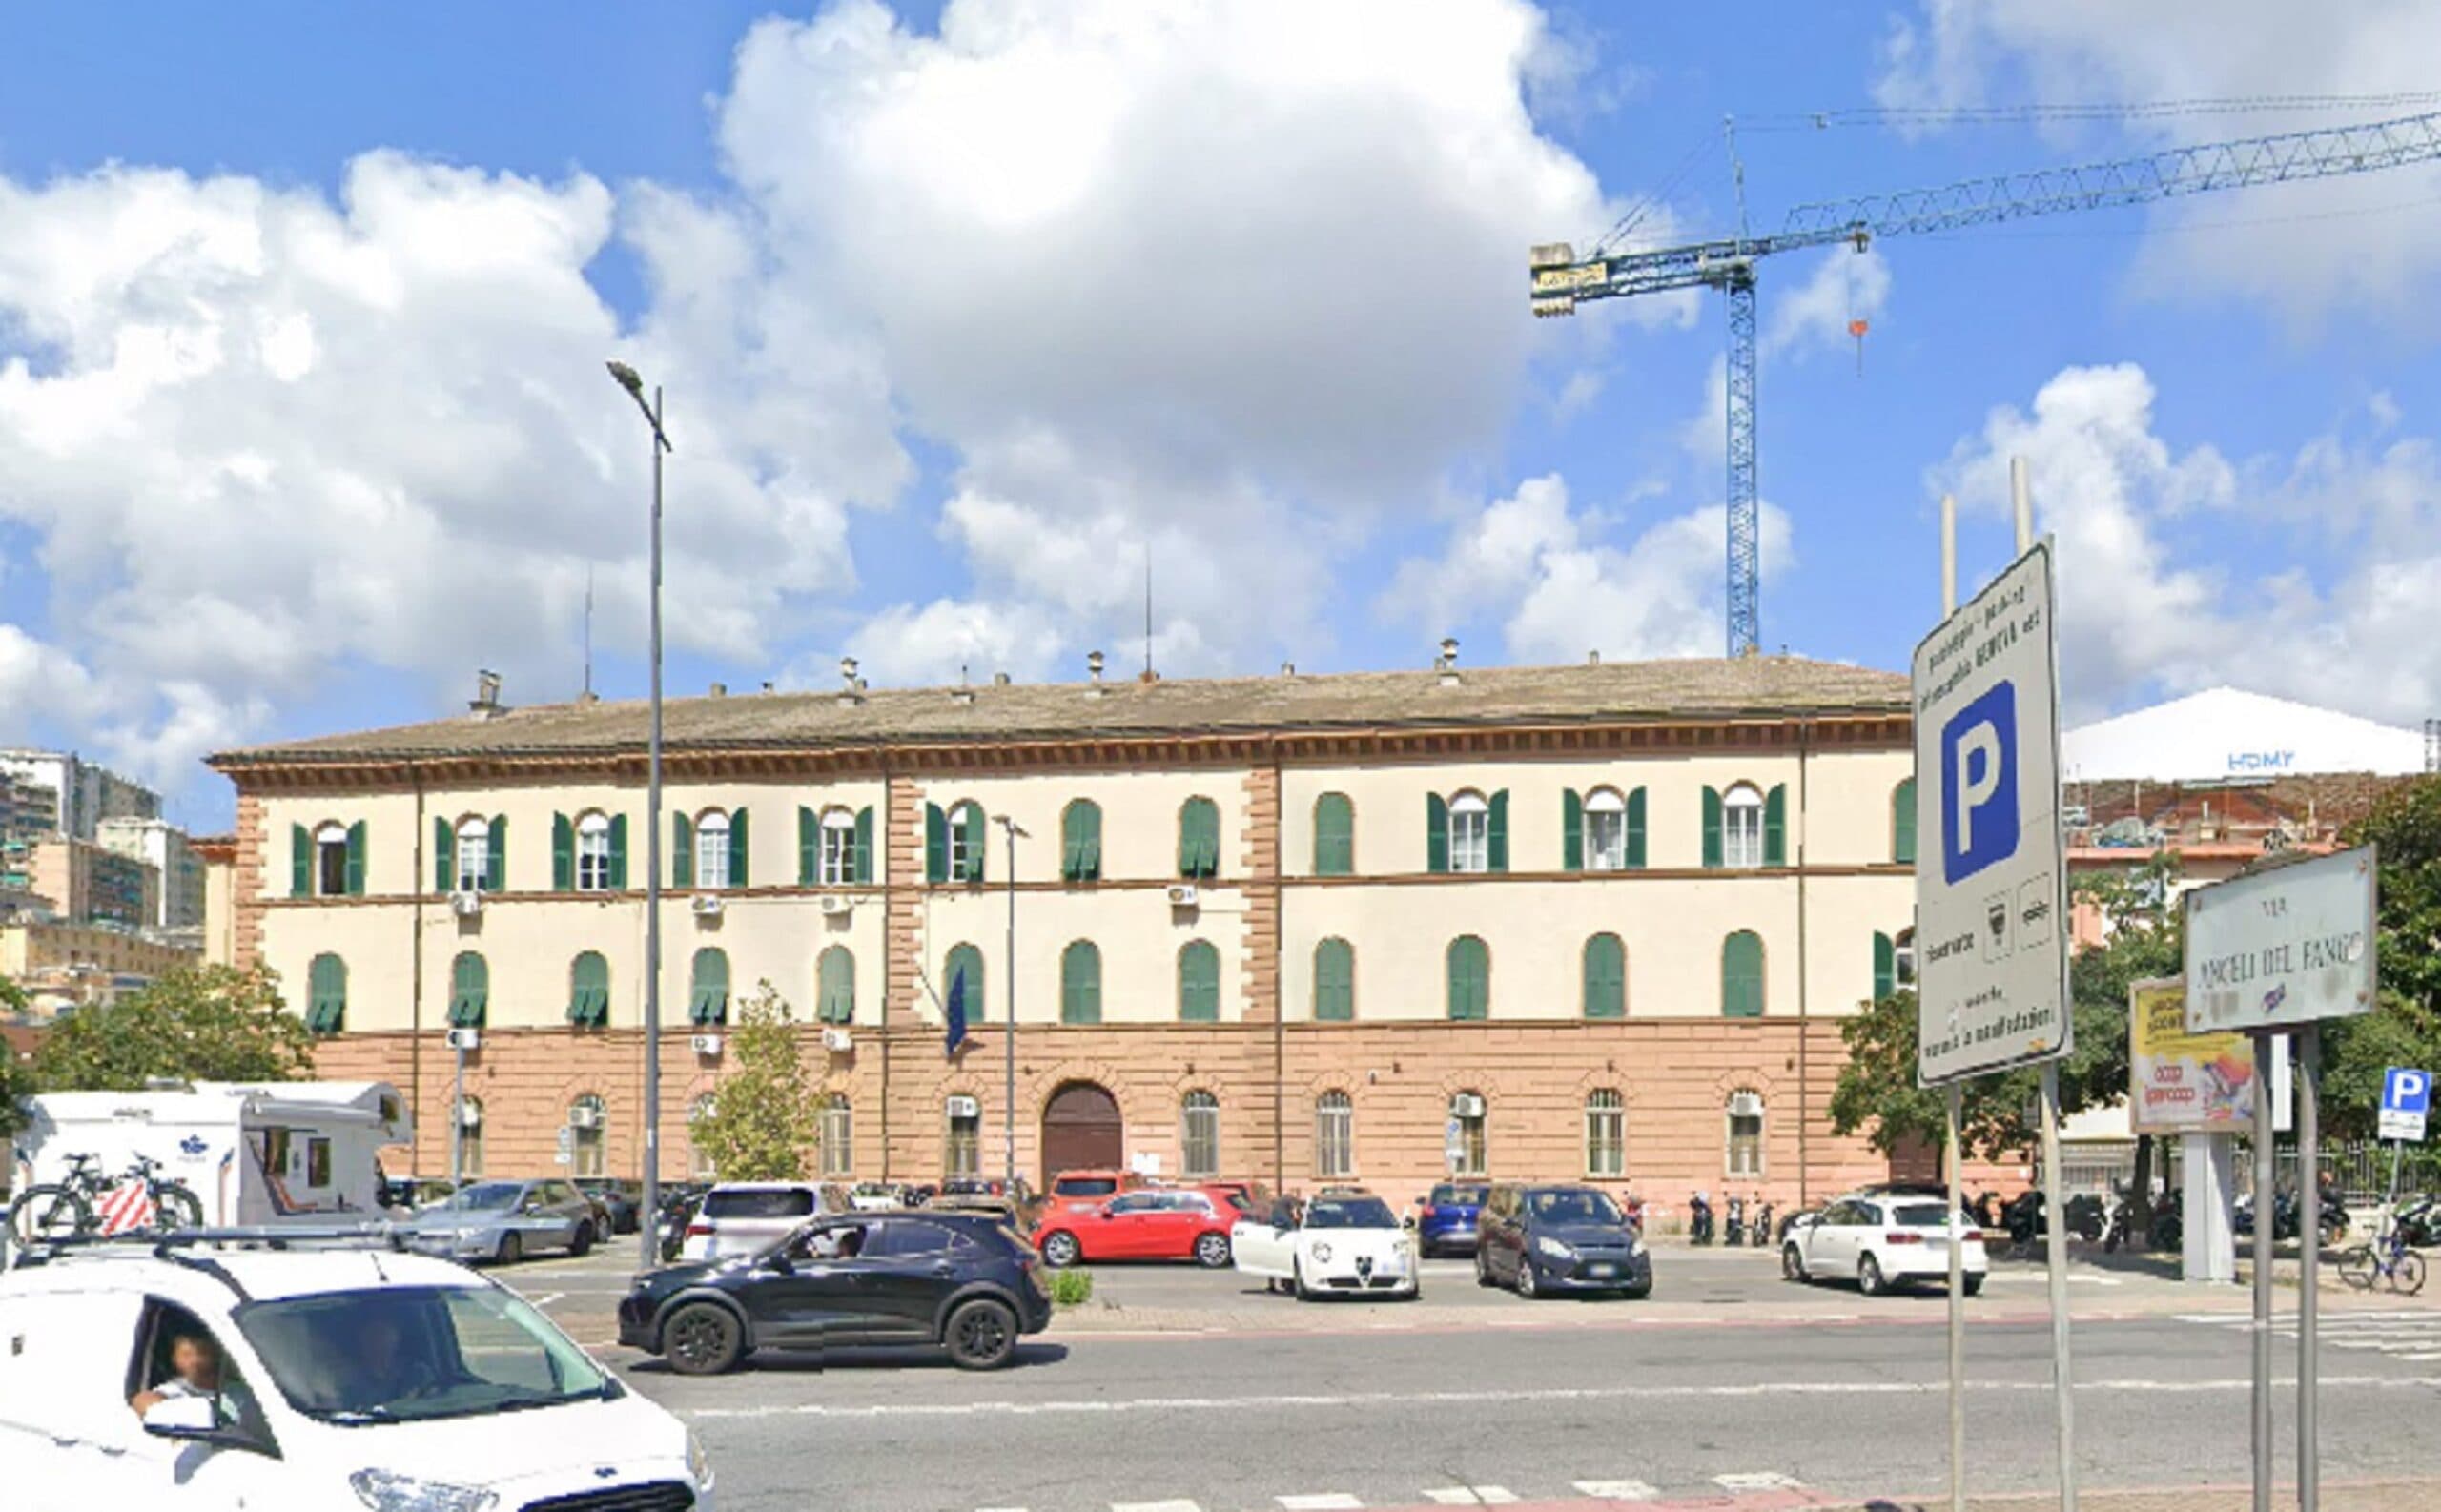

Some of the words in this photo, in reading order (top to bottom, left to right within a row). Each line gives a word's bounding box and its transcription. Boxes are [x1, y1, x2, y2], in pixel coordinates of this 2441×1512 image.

[1957, 719, 2001, 856] P
[2261, 896, 2288, 918] VIA
[2263, 943, 2295, 977] DEL
[2392, 1072, 2424, 1109] P
